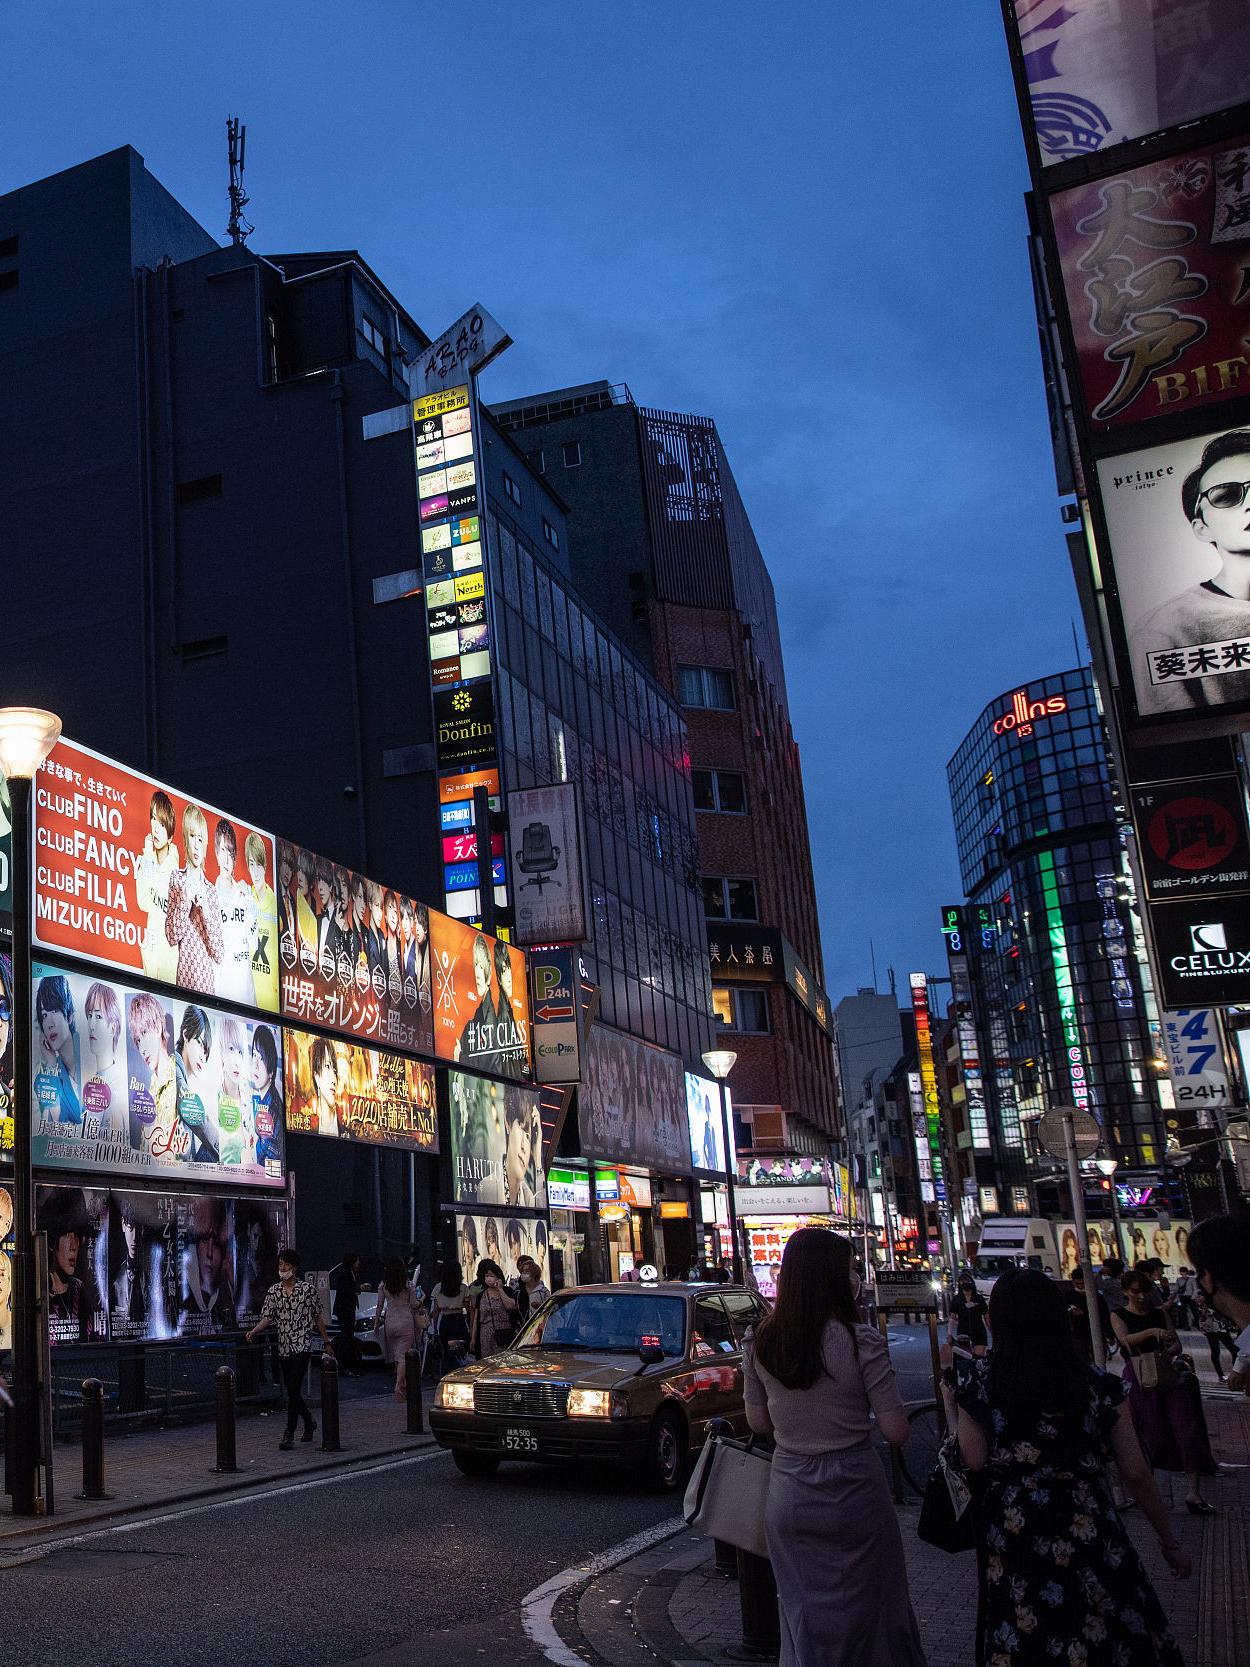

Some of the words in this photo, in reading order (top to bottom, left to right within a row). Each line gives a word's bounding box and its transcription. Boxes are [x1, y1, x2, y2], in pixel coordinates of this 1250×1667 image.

[1076, 179, 1209, 420] 大江戸
[424, 312, 483, 380] ARAO
[1152, 355, 1249, 406] B1F
[417, 397, 466, 418] 管理事務所
[425, 396, 457, 404] アラオビル
[1113, 466, 1174, 489] prince
[449, 496, 476, 507] VANPS
[457, 582, 483, 596] North
[438, 722, 493, 743] Donfin
[1138, 795, 1155, 807] 1F
[37, 788, 123, 837] CLUBFINO
[37, 826, 143, 880] CLUBFANCY
[37, 865, 129, 913] CLUBFILIA
[1152, 870, 1250, 889] 新宿ゴールデン街発祥
[37, 893, 101, 936] MIZUKI
[103, 914, 158, 952] GROUP
[251, 935, 270, 966] X
[709, 941, 775, 965] 美人茶屋
[1170, 950, 1250, 972] CELUX
[251, 961, 271, 975] RATED
[1179, 967, 1250, 978] FINE&LUXURY
[535, 965, 562, 1001] P
[547, 987, 571, 1000] 24h
[282, 975, 419, 1048] 世界をオレンジに照らす。
[468, 1022, 495, 1051] #1ST
[496, 1019, 527, 1047] CLASS
[502, 1048, 530, 1063] ファーストクラス
[1165, 1021, 1186, 1077] 東宝ビル前
[129, 1076, 145, 1092] Ban
[1178, 1083, 1227, 1100] 24H
[350, 1097, 436, 1134] 2020店舗売上No.1
[456, 1156, 503, 1181] HARUTO
[549, 1185, 575, 1203] FamilyMart
[751, 1233, 781, 1247] 無料
[753, 1249, 782, 1262] 案内
[641, 1336, 660, 1347] 空車
[506, 1436, 538, 1451] 52-35
[518, 1429, 531, 1437] 500
